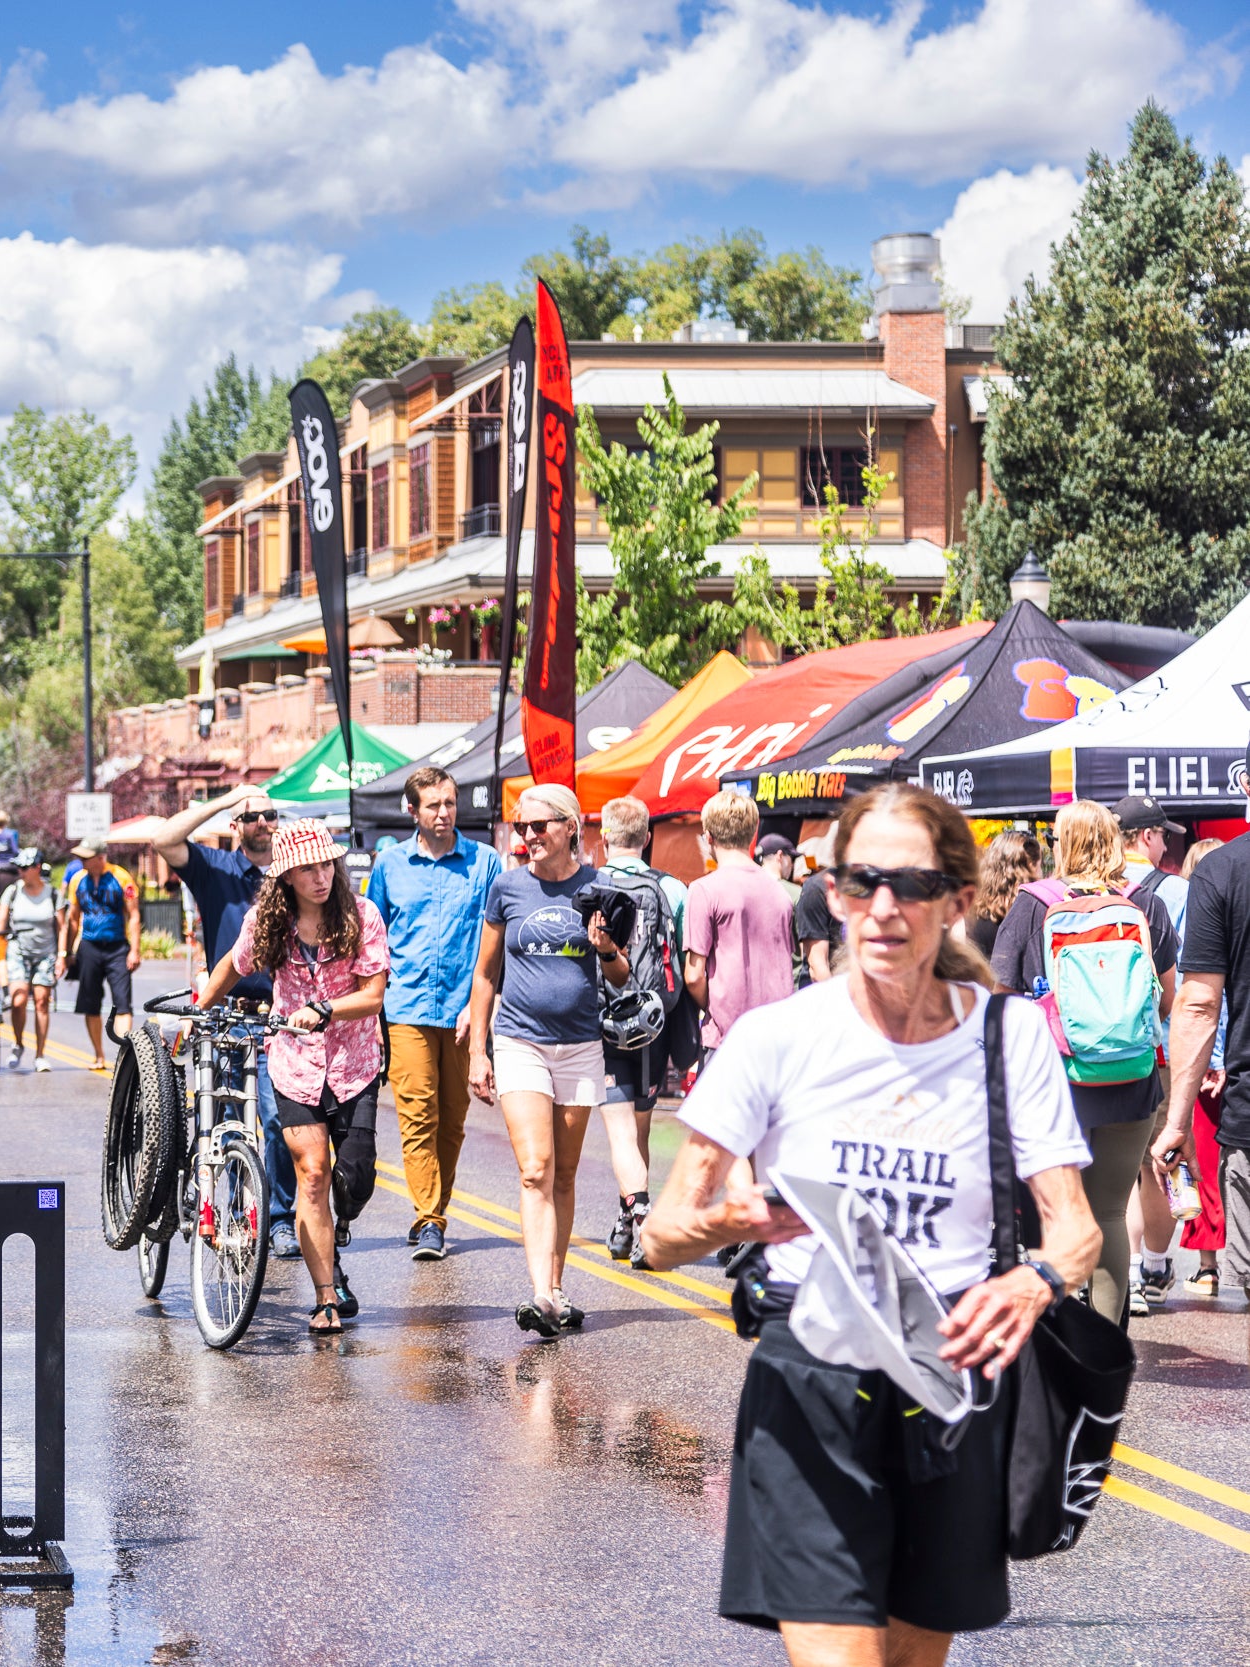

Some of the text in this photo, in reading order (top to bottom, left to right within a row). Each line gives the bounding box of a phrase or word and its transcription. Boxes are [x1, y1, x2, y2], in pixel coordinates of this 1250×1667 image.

[756, 772, 776, 808] Big
[777, 769, 816, 801] Bobble
[818, 772, 847, 798] Hats
[1128, 757, 1220, 796] ELIEL
[832, 1139, 957, 1190] TRAIL
